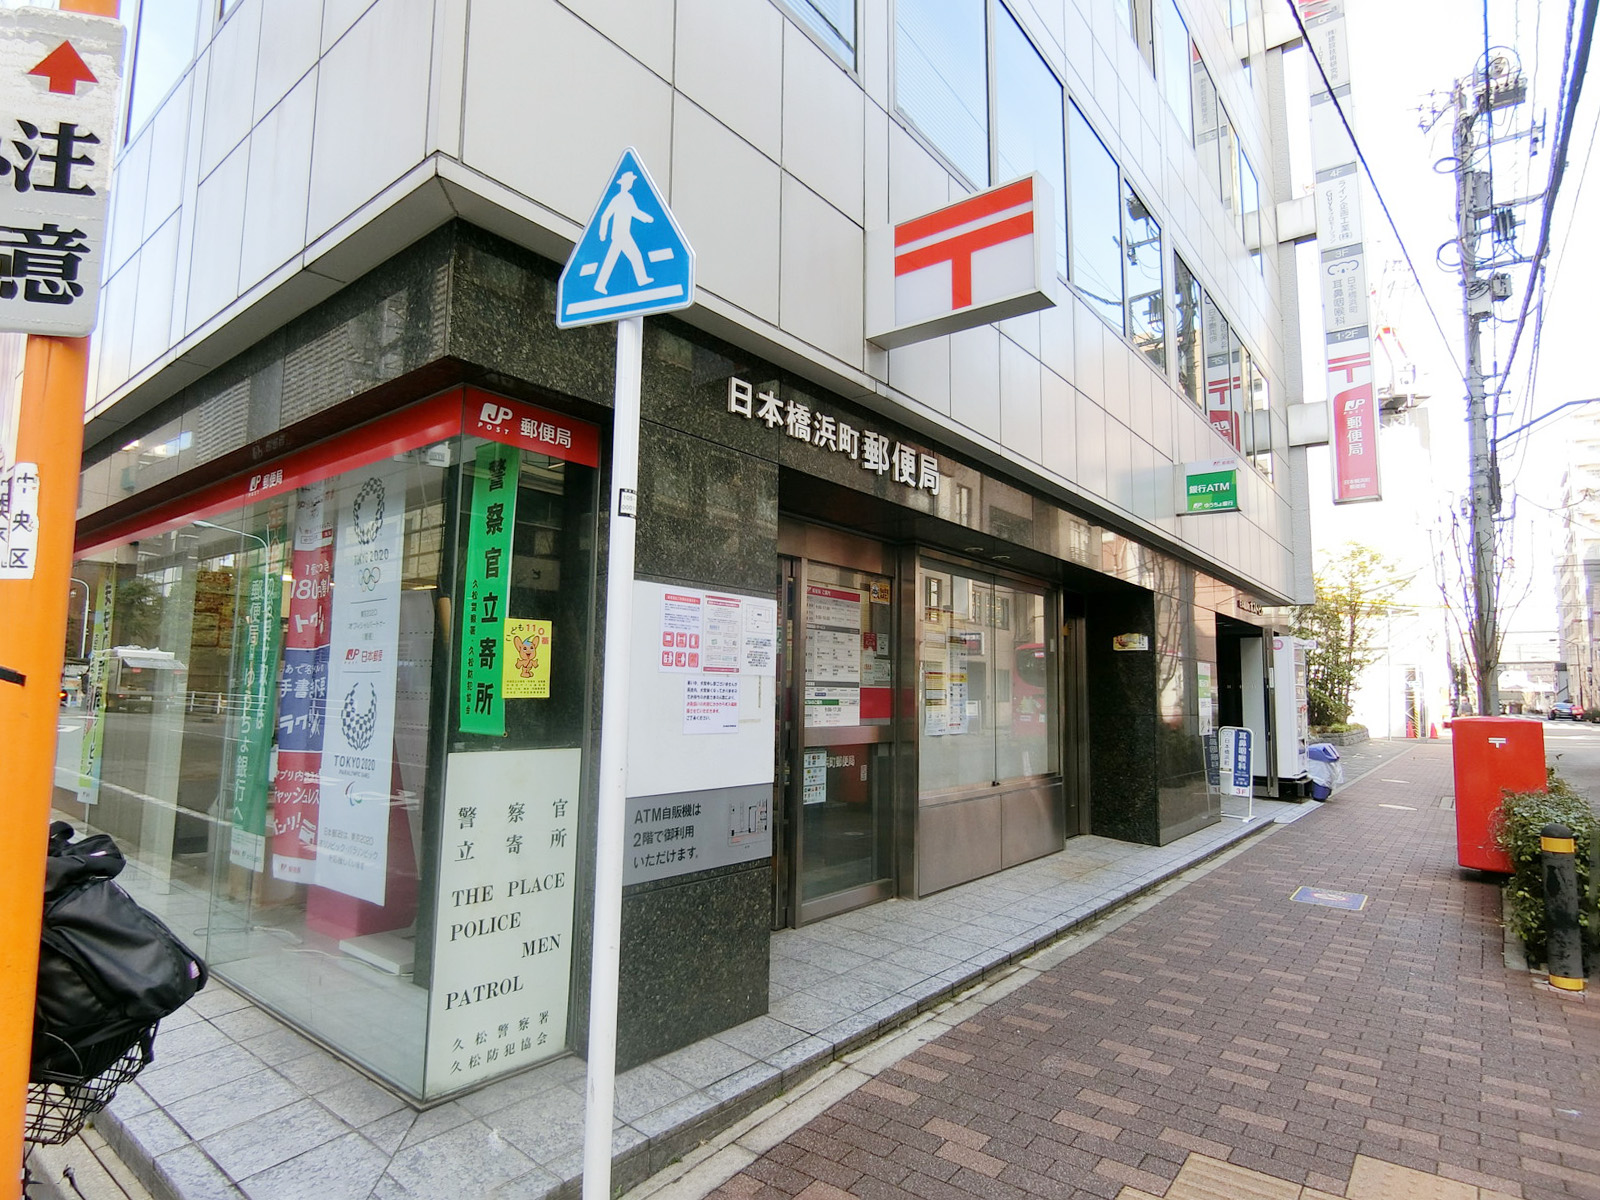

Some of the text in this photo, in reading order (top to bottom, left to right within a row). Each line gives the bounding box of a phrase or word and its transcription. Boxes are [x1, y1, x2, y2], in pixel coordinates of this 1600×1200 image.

[1330, 168, 1343, 178] 4F
[1335, 249, 1350, 258] 3F
[477, 422, 510, 435] POST
[520, 417, 572, 449] 郵便局
[727, 376, 941, 496] 日本橋浜町郵便局
[1346, 416, 1363, 457] 郵便局
[1188, 481, 1230, 494] 銀行ATM
[474, 457, 507, 716] 警察官立寄所
[334, 754, 376, 771] TOKYO 2020
[457, 798, 568, 830] 警察官
[634, 802, 702, 825] ATM自販機は
[454, 828, 567, 862] 立寄所
[633, 825, 695, 848] 2階で御利用
[633, 846, 699, 869] いただけます。
[452, 872, 566, 908] THE PLACE
[450, 911, 522, 943] POLICE
[521, 934, 562, 959] MEN
[444, 975, 524, 1012] PATROL
[452, 1010, 550, 1051] 久松警察署
[450, 1031, 548, 1075] 久松防犯協会
